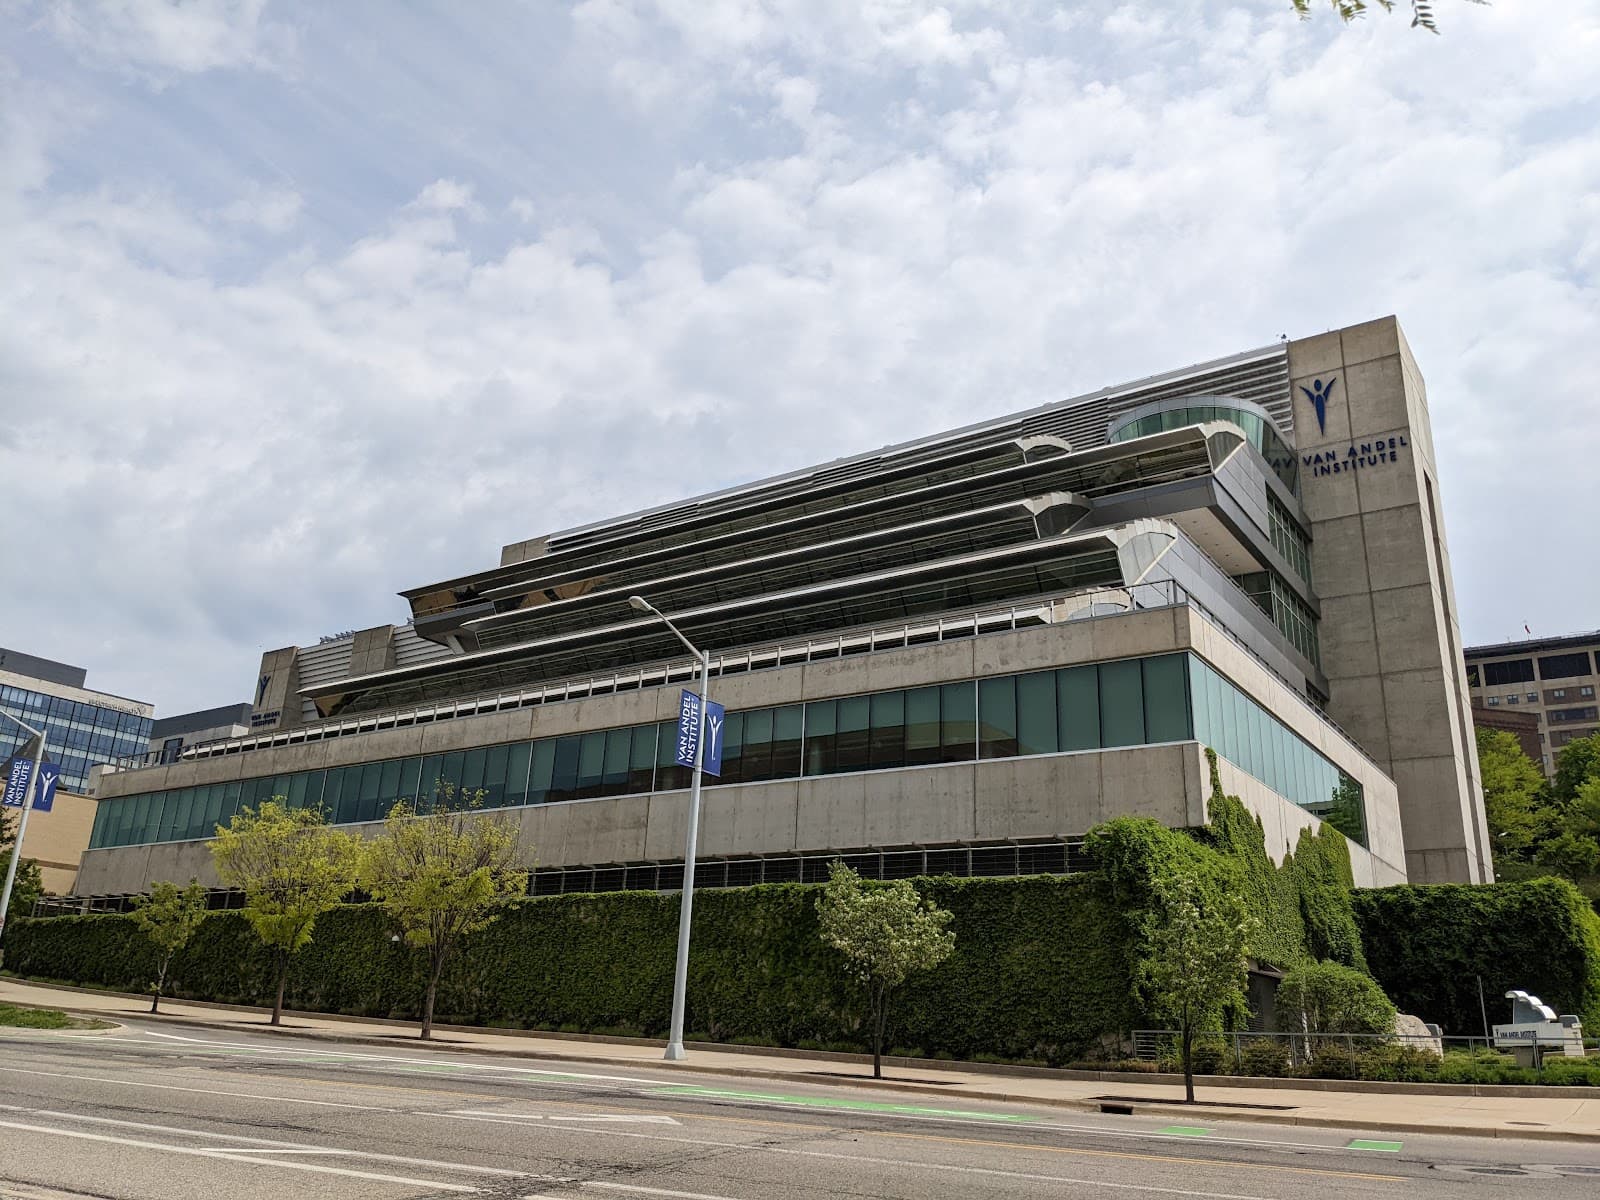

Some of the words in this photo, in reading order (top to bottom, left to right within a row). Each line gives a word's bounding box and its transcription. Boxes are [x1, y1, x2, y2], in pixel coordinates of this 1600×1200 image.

[1302, 450, 1336, 467] VAN
[1348, 436, 1408, 457] ANDEL
[1314, 451, 1397, 477] INSTITUTE
[681, 695, 691, 734] ANDEL
[686, 703, 698, 762] INSTITUTE
[678, 736, 688, 761] VAN
[5, 789, 15, 803] VAN
[11, 760, 23, 786] ANDEL
[14, 765, 29, 805] INSTITUTE
